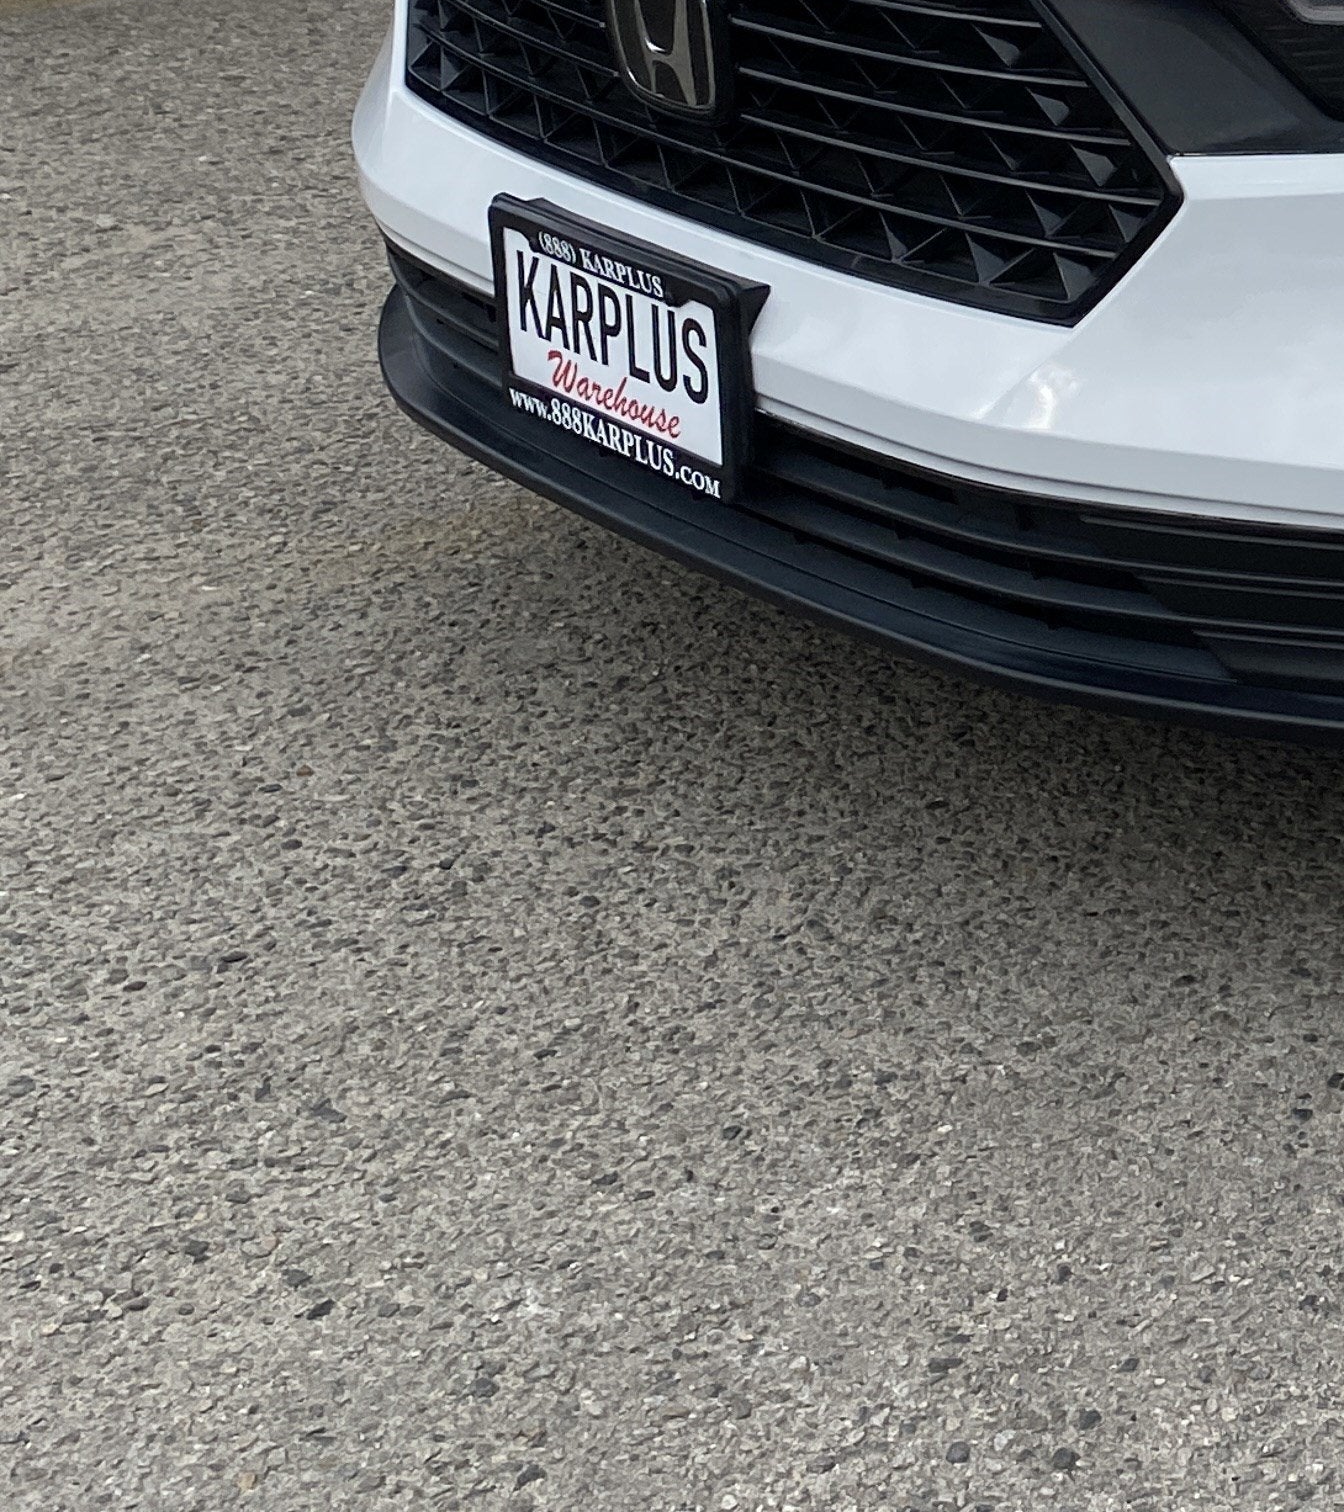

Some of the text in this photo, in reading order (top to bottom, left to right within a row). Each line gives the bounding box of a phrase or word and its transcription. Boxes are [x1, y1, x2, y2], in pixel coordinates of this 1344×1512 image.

[538, 230, 664, 299] (888) KARPLUS
[516, 249, 709, 405] KARPLUS
[547, 349, 682, 439] Warehouse
